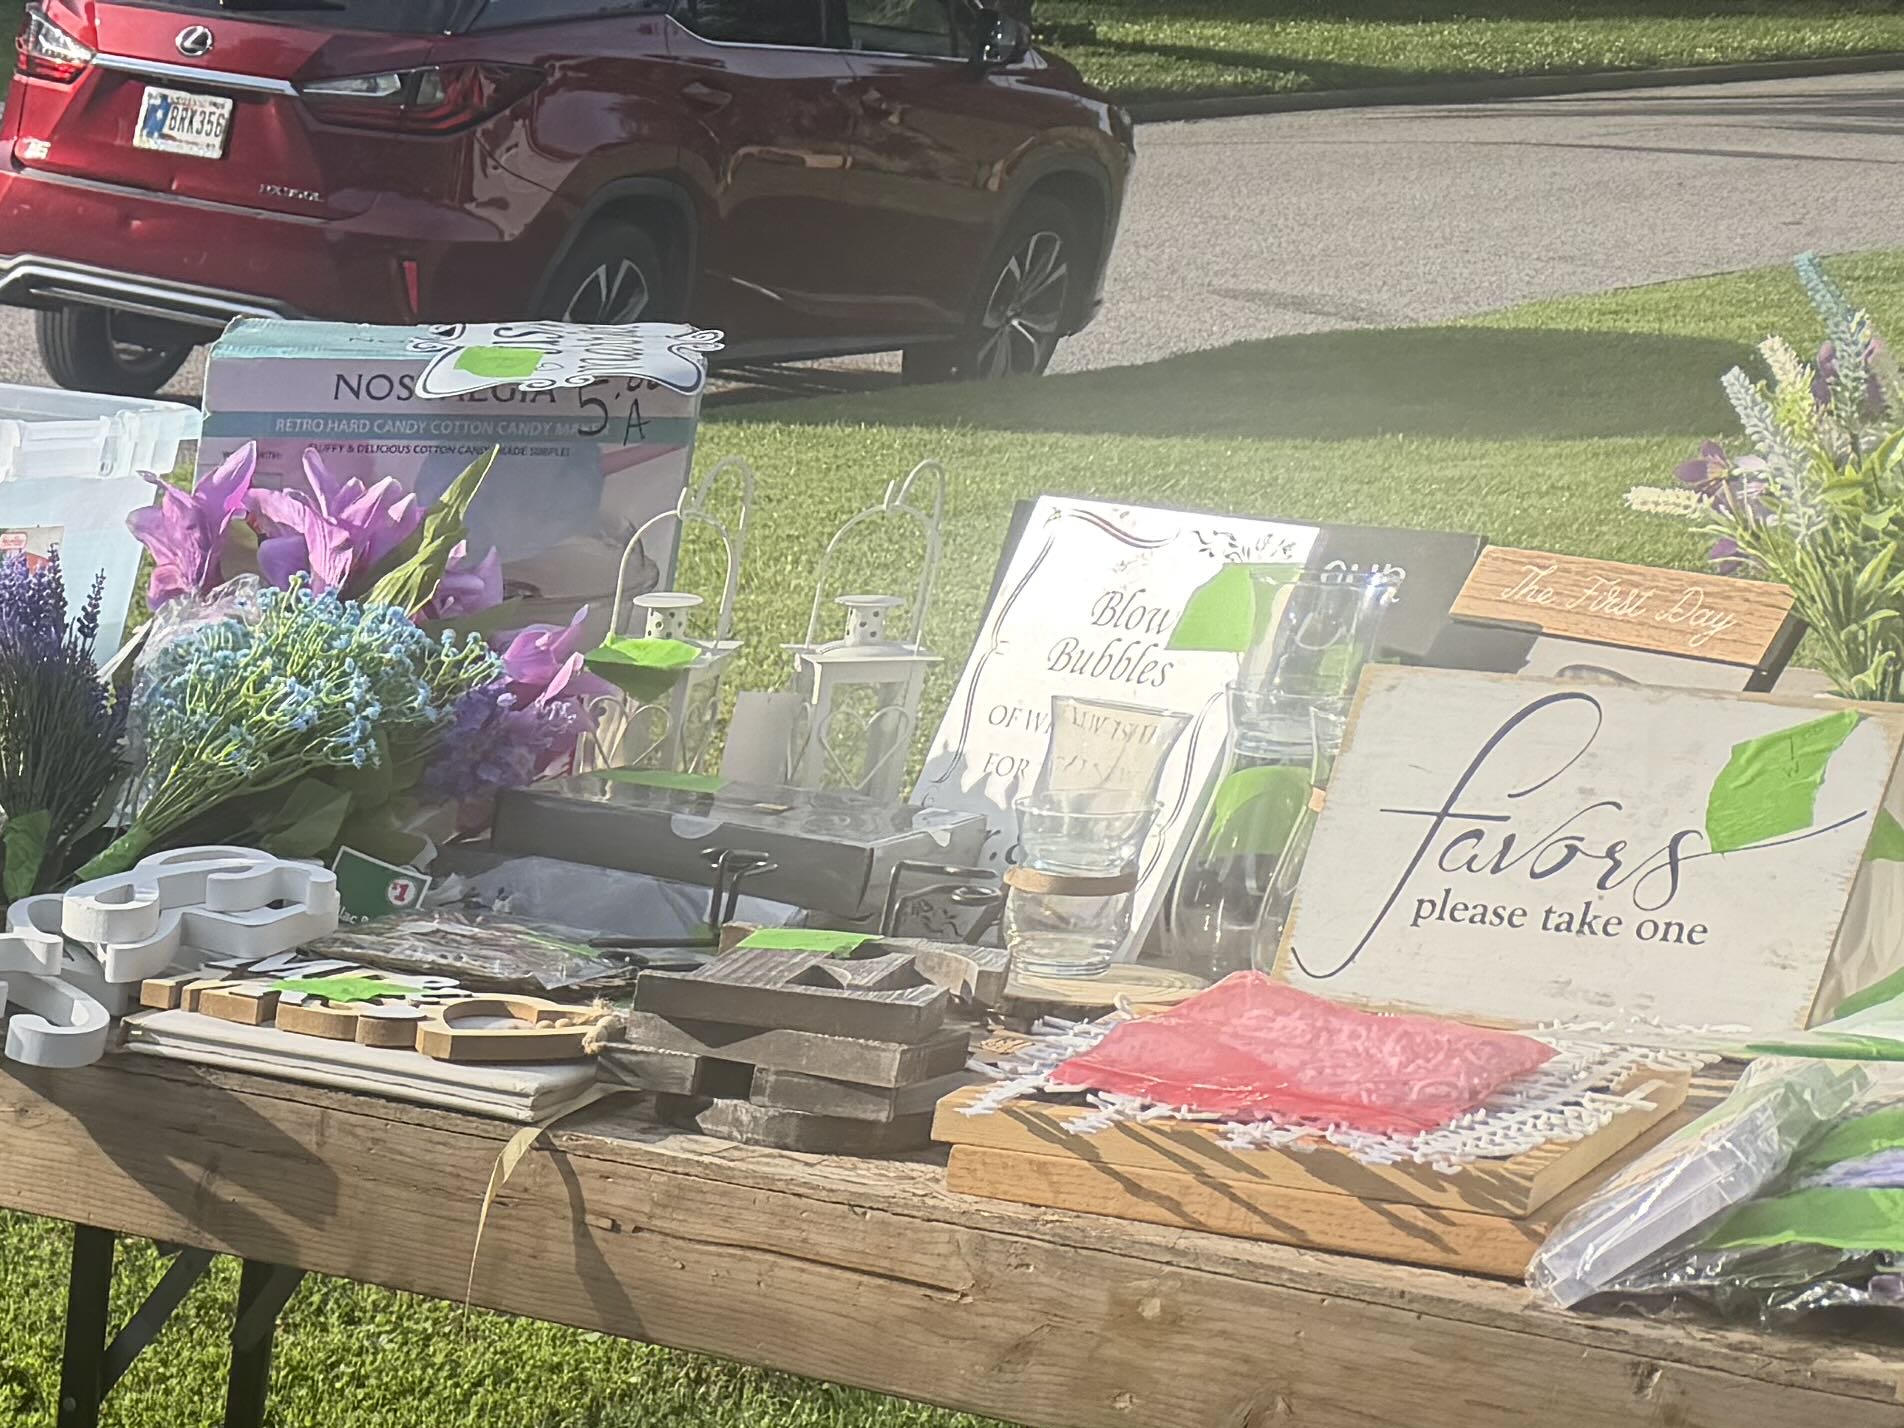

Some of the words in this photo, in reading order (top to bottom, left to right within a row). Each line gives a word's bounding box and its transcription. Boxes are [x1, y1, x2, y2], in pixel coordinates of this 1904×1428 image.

[334, 373, 556, 404] NOSGIA
[275, 418, 324, 433] RETRO
[326, 418, 370, 433] HARD
[373, 419, 427, 434] CANDY
[430, 420, 492, 434] COTTON
[496, 420, 553, 435] CANDY
[356, 443, 411, 455] DELICIOUS
[413, 444, 457, 455] COTTON
[1500, 564, 1558, 608] The
[1566, 574, 1656, 620] First
[1656, 586, 1738, 648] Day
[1047, 636, 1175, 688] Bubbles
[988, 704, 1025, 728] OF
[983, 752, 1030, 778] FOR
[1291, 692, 1868, 979] favors
[1410, 887, 1528, 928] please
[1540, 899, 1624, 938] take
[1633, 917, 1710, 946] one
